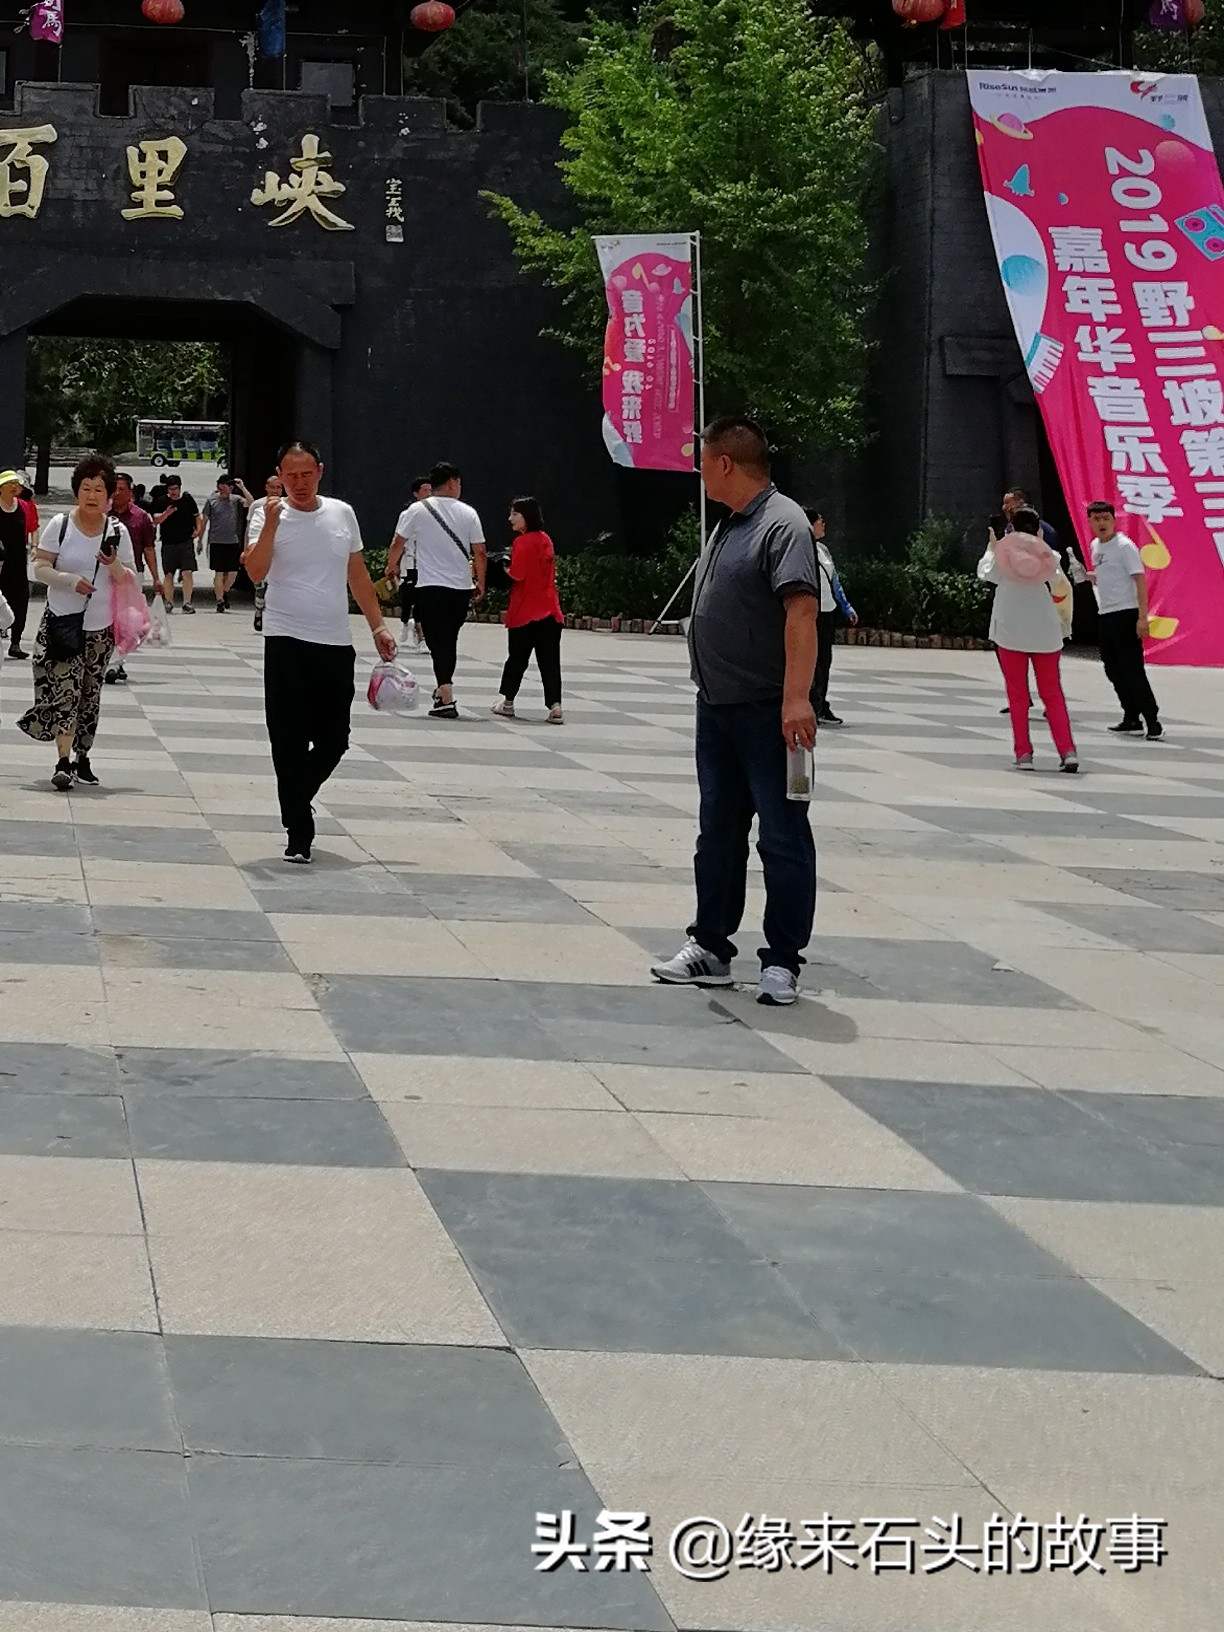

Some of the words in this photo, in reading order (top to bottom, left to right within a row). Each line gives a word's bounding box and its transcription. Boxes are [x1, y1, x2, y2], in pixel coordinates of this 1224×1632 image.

[1047, 224, 1185, 524] 嘉年华音乐季
